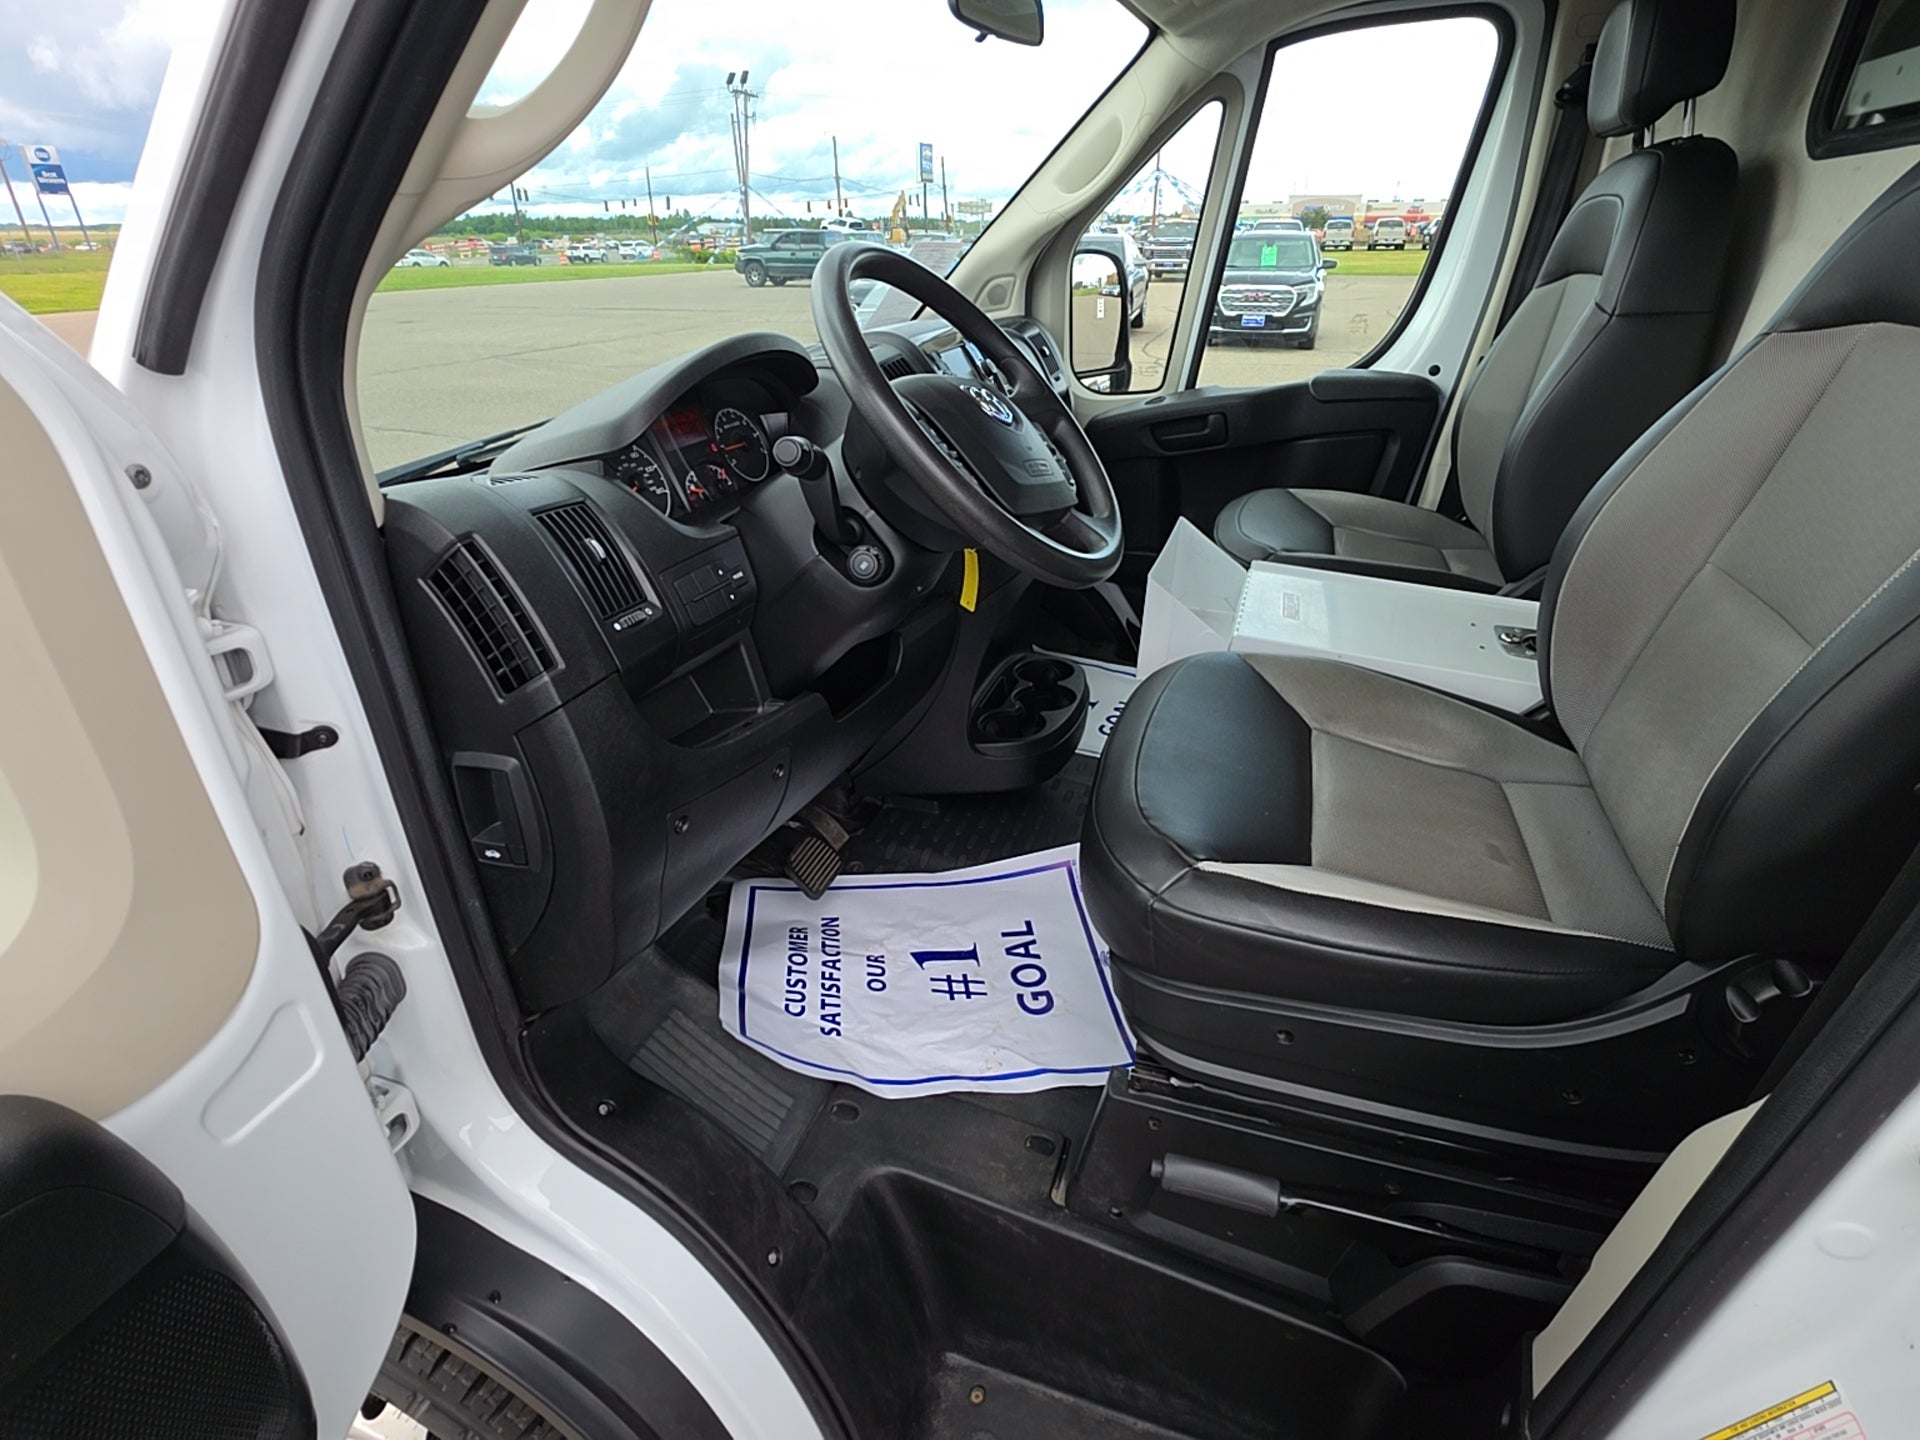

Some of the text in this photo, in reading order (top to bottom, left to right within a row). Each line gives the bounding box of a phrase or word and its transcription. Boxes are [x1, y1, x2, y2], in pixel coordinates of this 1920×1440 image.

[783, 926, 809, 1018] CUSTOMER
[819, 916, 842, 1037] SATISFACTION
[865, 954, 887, 992] OUR
[909, 942, 989, 1001] #1
[1000, 919, 1055, 1016] GOAL
